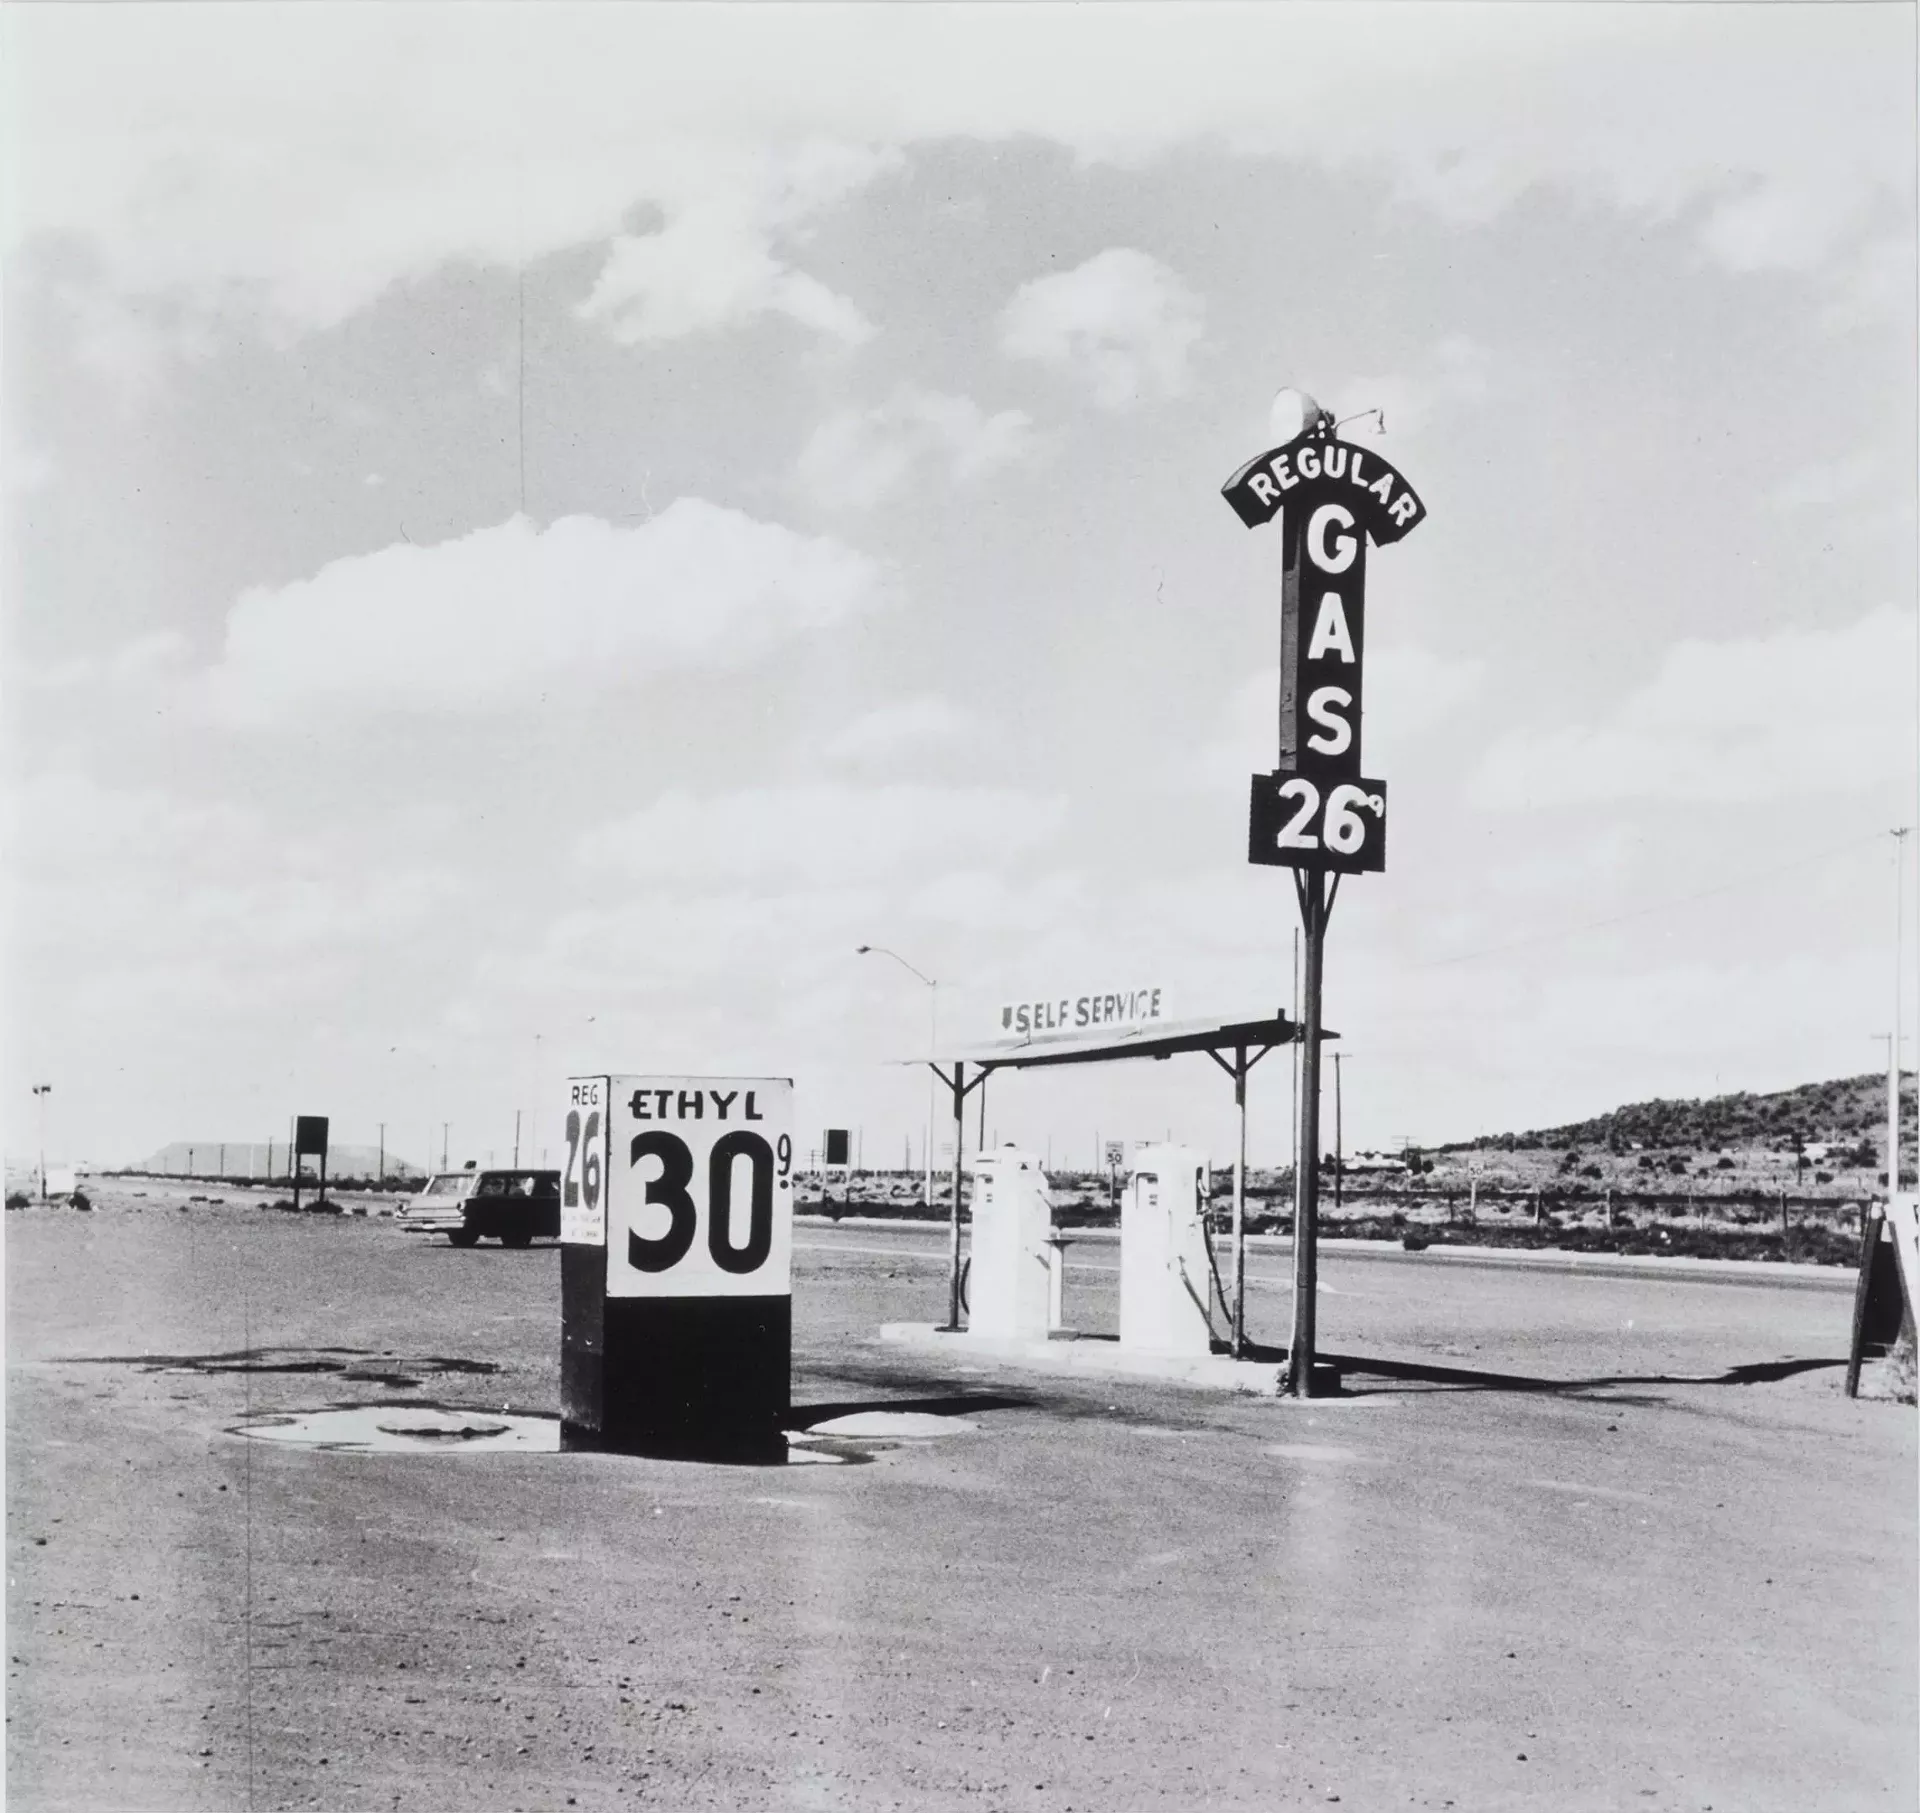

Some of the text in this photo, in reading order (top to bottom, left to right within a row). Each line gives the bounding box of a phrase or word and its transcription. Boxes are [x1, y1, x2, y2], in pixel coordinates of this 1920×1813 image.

[1248, 445, 1417, 526] REGULAR
[1306, 503, 1357, 756] GAS
[1015, 988, 1161, 1033] SELF SERVICE
[628, 1090, 763, 1120] ETHYL
[563, 1109, 601, 1211] 26
[1107, 1152, 1122, 1163] 50
